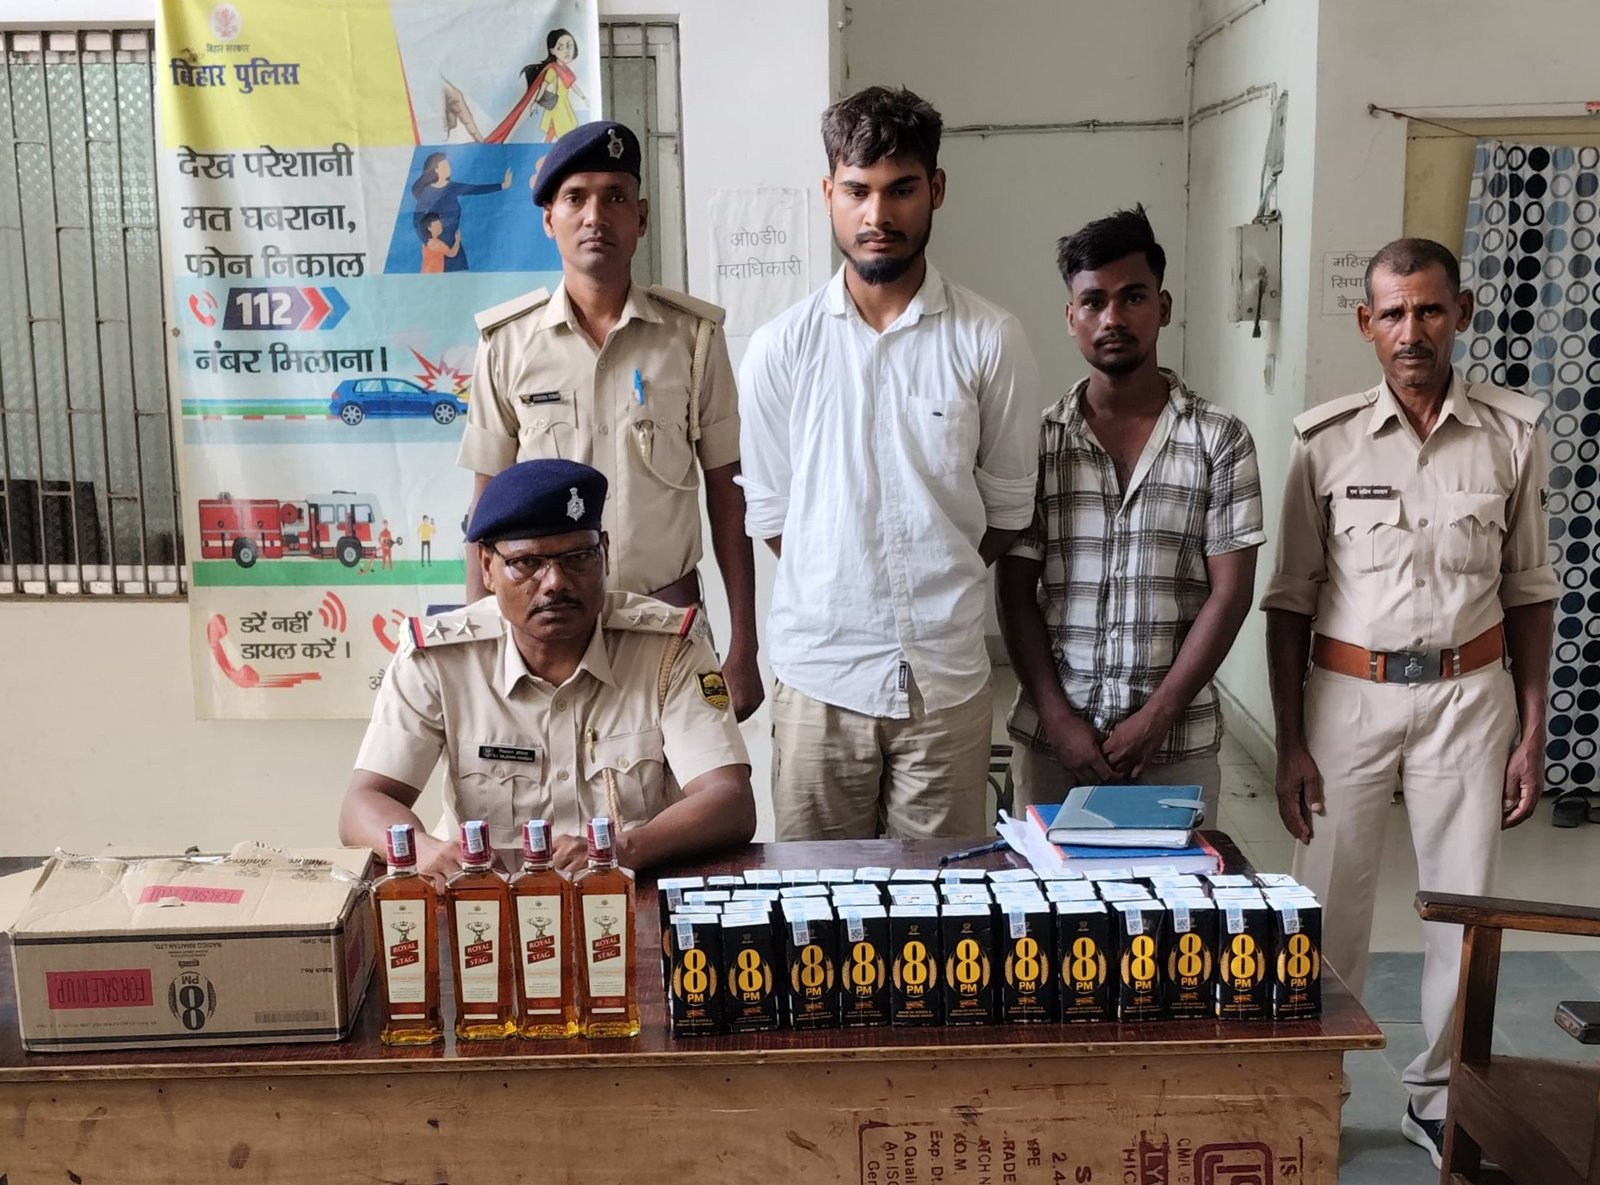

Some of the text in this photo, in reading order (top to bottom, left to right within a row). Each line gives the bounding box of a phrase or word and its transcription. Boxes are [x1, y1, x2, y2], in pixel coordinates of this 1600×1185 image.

[169, 57, 300, 94] बिहार पुलिस
[176, 142, 354, 179] देख परेशानी
[181, 205, 356, 234] मत घबराना,
[184, 245, 366, 279] फोन निकाल
[717, 255, 802, 279] पदाधिकारी
[1331, 275, 1364, 288] सिपा
[235, 292, 293, 326] 112
[193, 340, 262, 374] नंबर
[240, 610, 313, 633] डरें नहीं
[240, 643, 297, 660] डायल
[301, 636, 337, 659] करें
[392, 942, 416, 954] ROYAL
[467, 943, 490, 954] ROYAL
[528, 937, 552, 949] ROYAL
[594, 936, 619, 947] ROYAL
[394, 955, 415, 965] STAG
[469, 955, 489, 965] STAG
[531, 951, 551, 961] STAG
[597, 949, 617, 959] STAG
[801, 945, 825, 987] 8
[852, 942, 876, 985] 8
[902, 941, 927, 985] 8
[956, 939, 981, 983] 8
[1015, 937, 1039, 981] 8
[1072, 937, 1096, 981] 8
[1131, 936, 1155, 980] 8
[1178, 933, 1202, 976] 8
[1231, 934, 1255, 978] 8
[1287, 934, 1311, 978] 8
[181, 975, 200, 985] PM
[683, 949, 708, 993] 8
[737, 949, 763, 992] 8
[1181, 977, 1198, 986] PM
[1290, 978, 1307, 987] PM
[90, 976, 119, 1003] SALE
[120, 976, 145, 1002] FOR
[805, 987, 822, 996] PM
[856, 986, 873, 995] PM
[906, 985, 924, 994] PM
[960, 984, 977, 993] PM
[1018, 982, 1035, 990] PM
[1076, 982, 1093, 991] PM
[1135, 981, 1152, 989] PM
[1234, 979, 1251, 987] PM
[179, 986, 206, 1031] 8
[687, 994, 704, 1003] PM
[743, 992, 760, 1001] PM
[904, 1130, 917, 1142] A
[928, 1130, 943, 1162] Exp.
[885, 1141, 899, 1161] An
[977, 1137, 992, 1172] ATCH
[1003, 1136, 1016, 1183] RADE
[1122, 1140, 1136, 1185] HIC
[1052, 1152, 1068, 1185] 2.4
